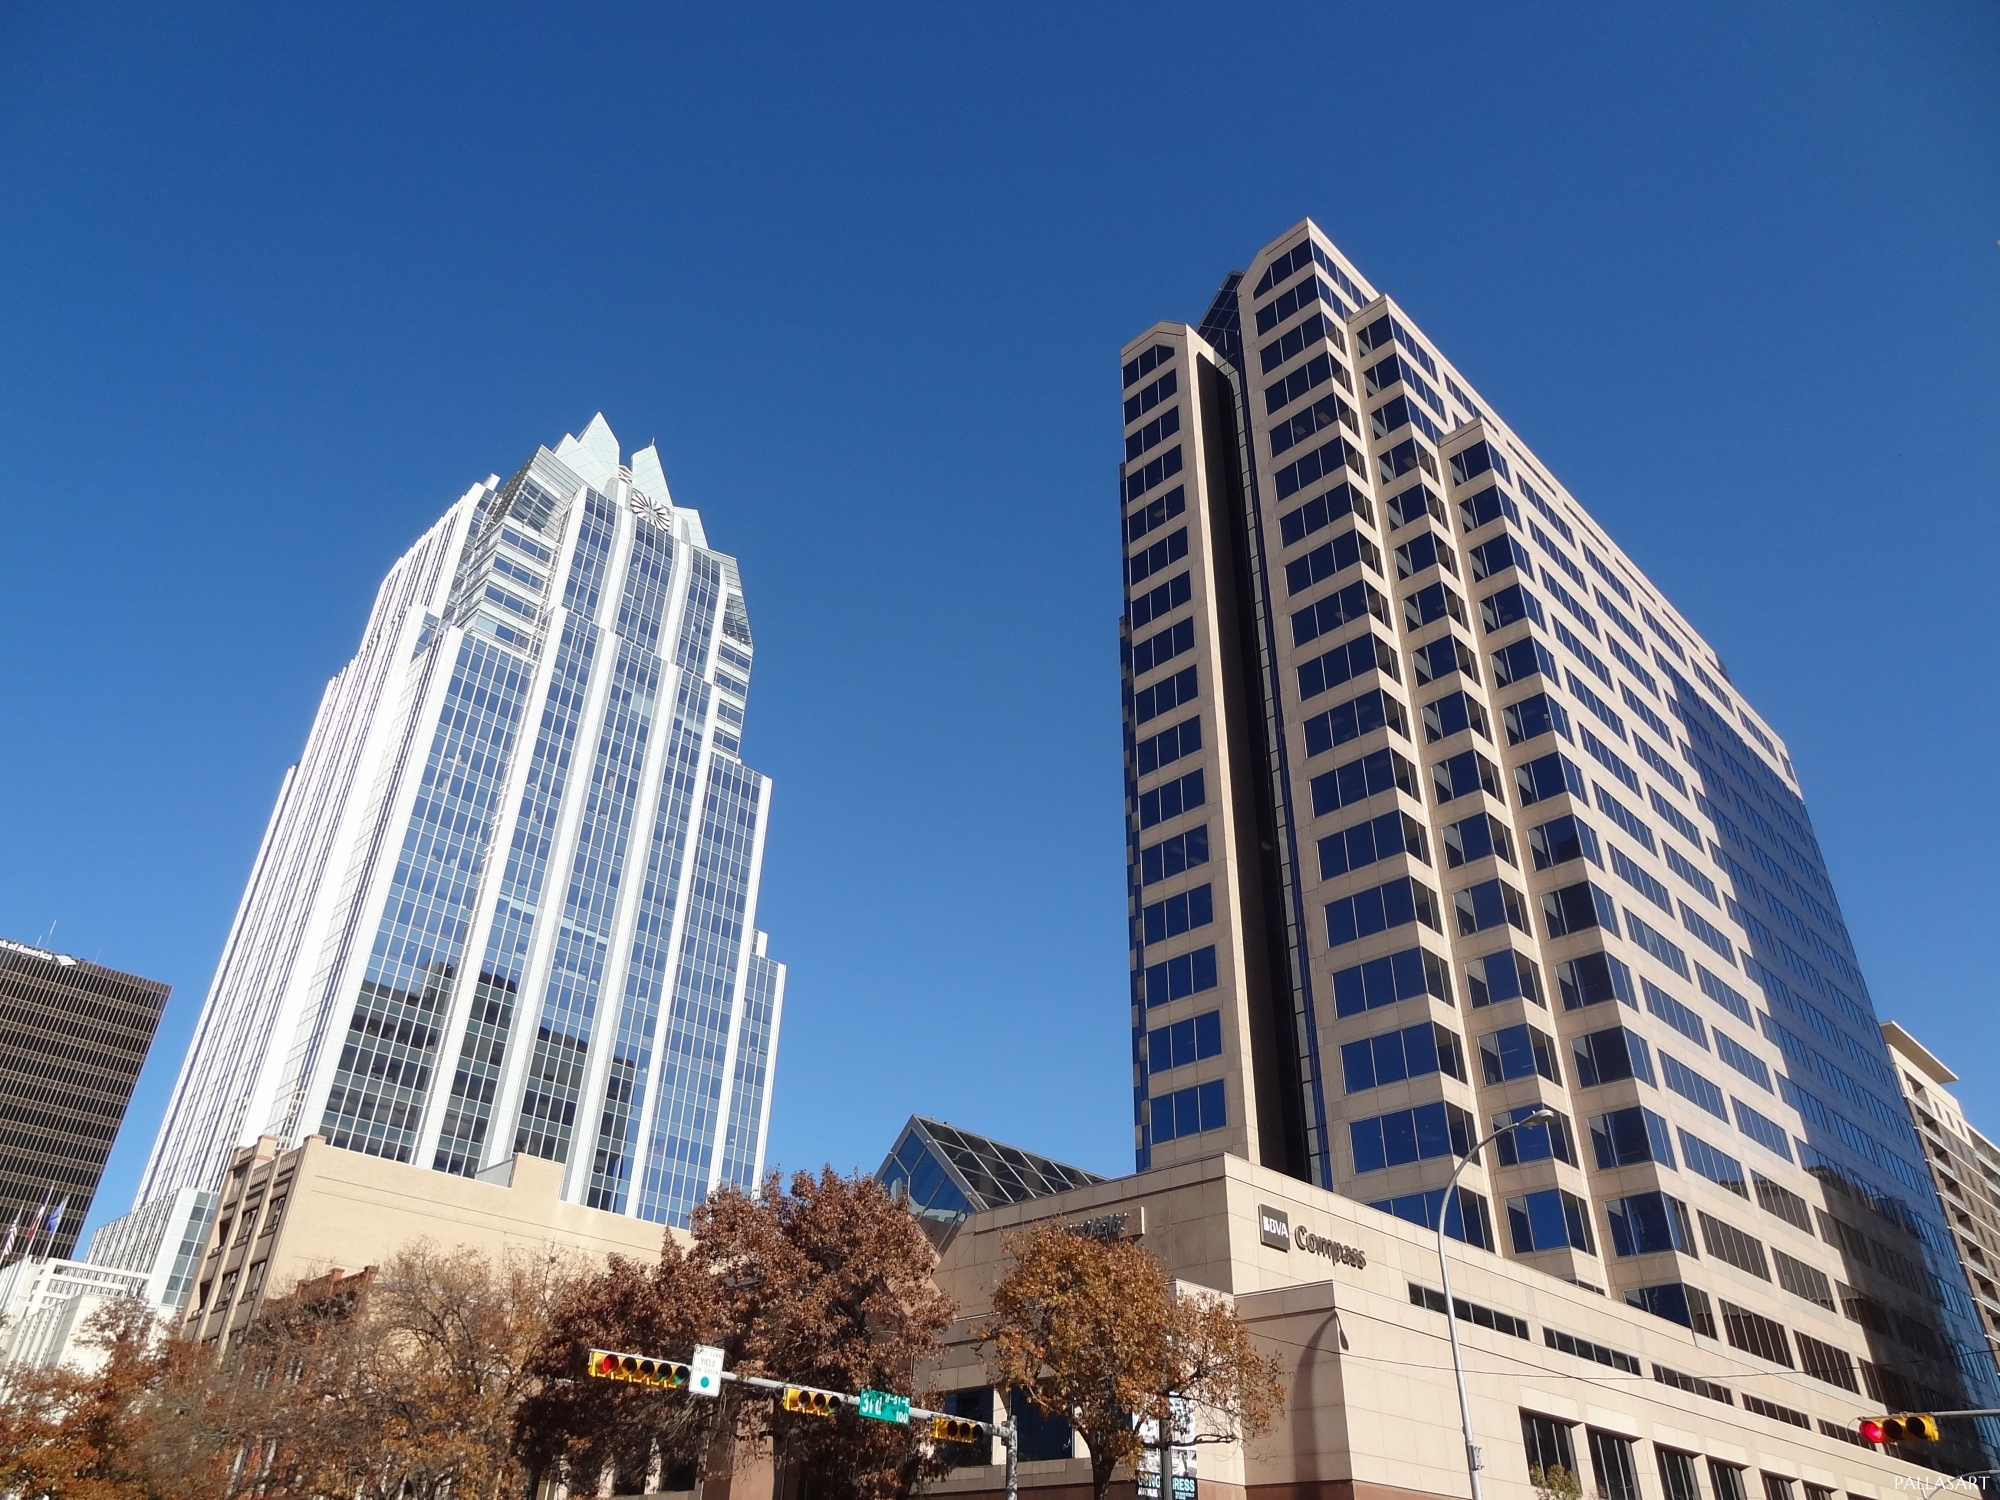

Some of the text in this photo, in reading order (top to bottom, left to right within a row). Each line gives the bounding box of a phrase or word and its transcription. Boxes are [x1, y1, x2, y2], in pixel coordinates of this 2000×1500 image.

[8, 943, 19, 951] of
[16, 944, 53, 961] America
[1263, 1216, 1367, 1271] BBVA Compass
[701, 1358, 716, 1367] YIELD
[861, 1392, 882, 1415] 3rd
[896, 1410, 908, 1423] 100
